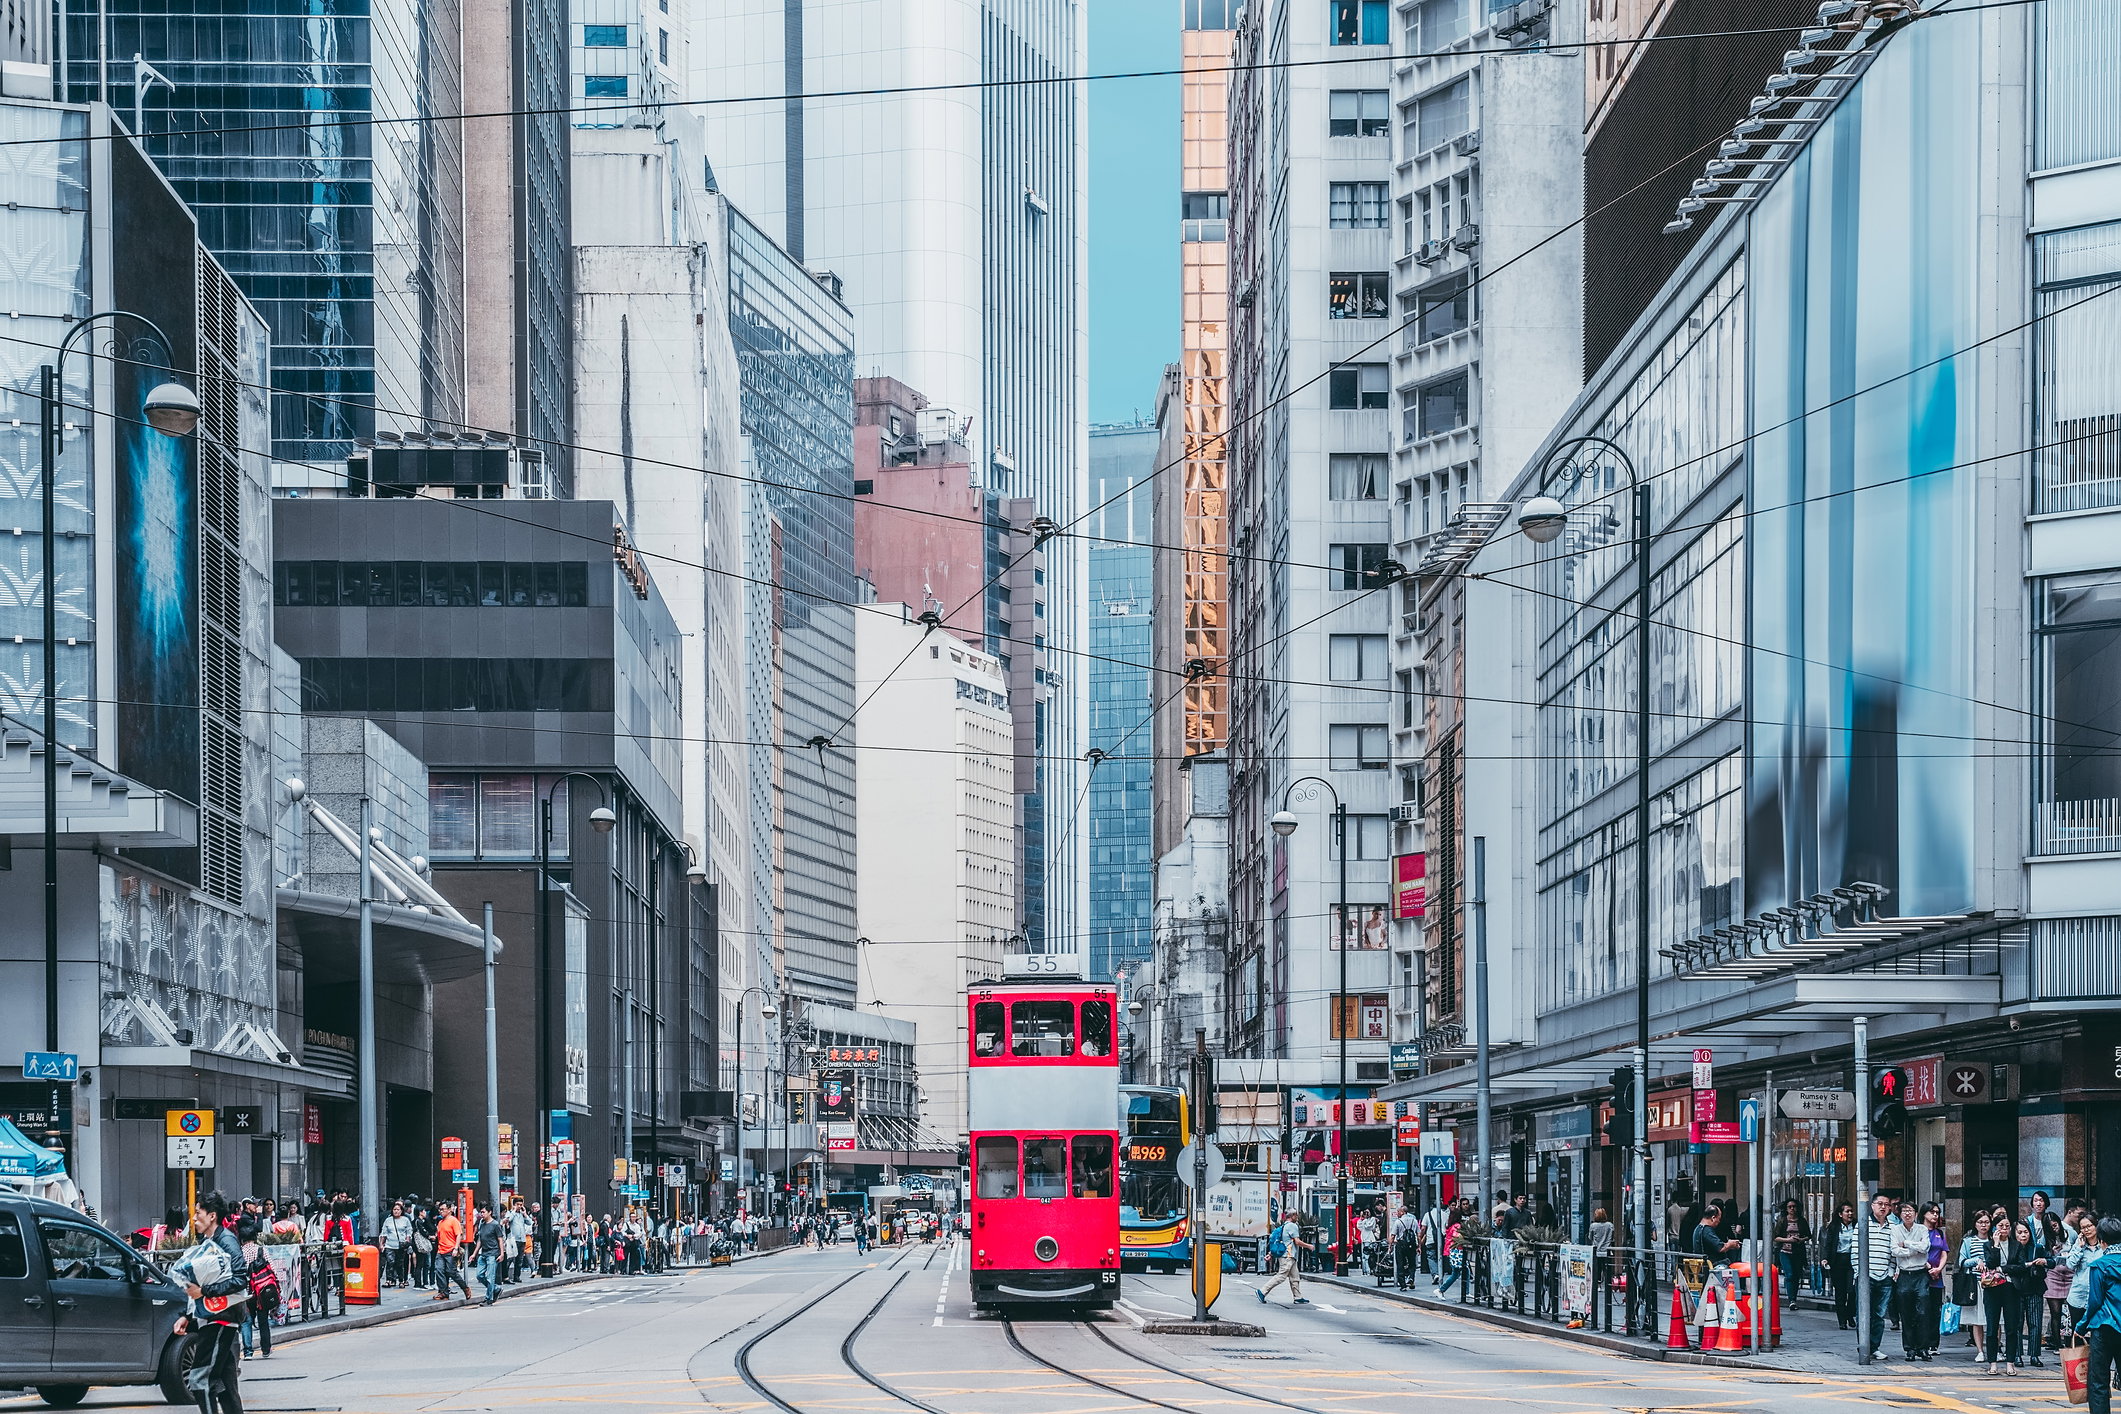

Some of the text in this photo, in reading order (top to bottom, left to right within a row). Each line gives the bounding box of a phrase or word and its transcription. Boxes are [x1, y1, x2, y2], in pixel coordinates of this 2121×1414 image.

[1027, 955, 1057, 972] 55
[979, 990, 992, 1000] 55
[1094, 988, 1107, 999] 55
[1368, 1007, 1383, 1037] 中醫
[1800, 1093, 1839, 1102] Rumsey St
[1802, 1102, 1837, 1110] 林士街
[17, 1112, 45, 1122] 上環站
[198, 1138, 206, 1150] 7
[828, 1140, 851, 1148] KFC
[1141, 1146, 1166, 1160] 969
[198, 1156, 206, 1166] 7
[1102, 1272, 1116, 1283] 55
